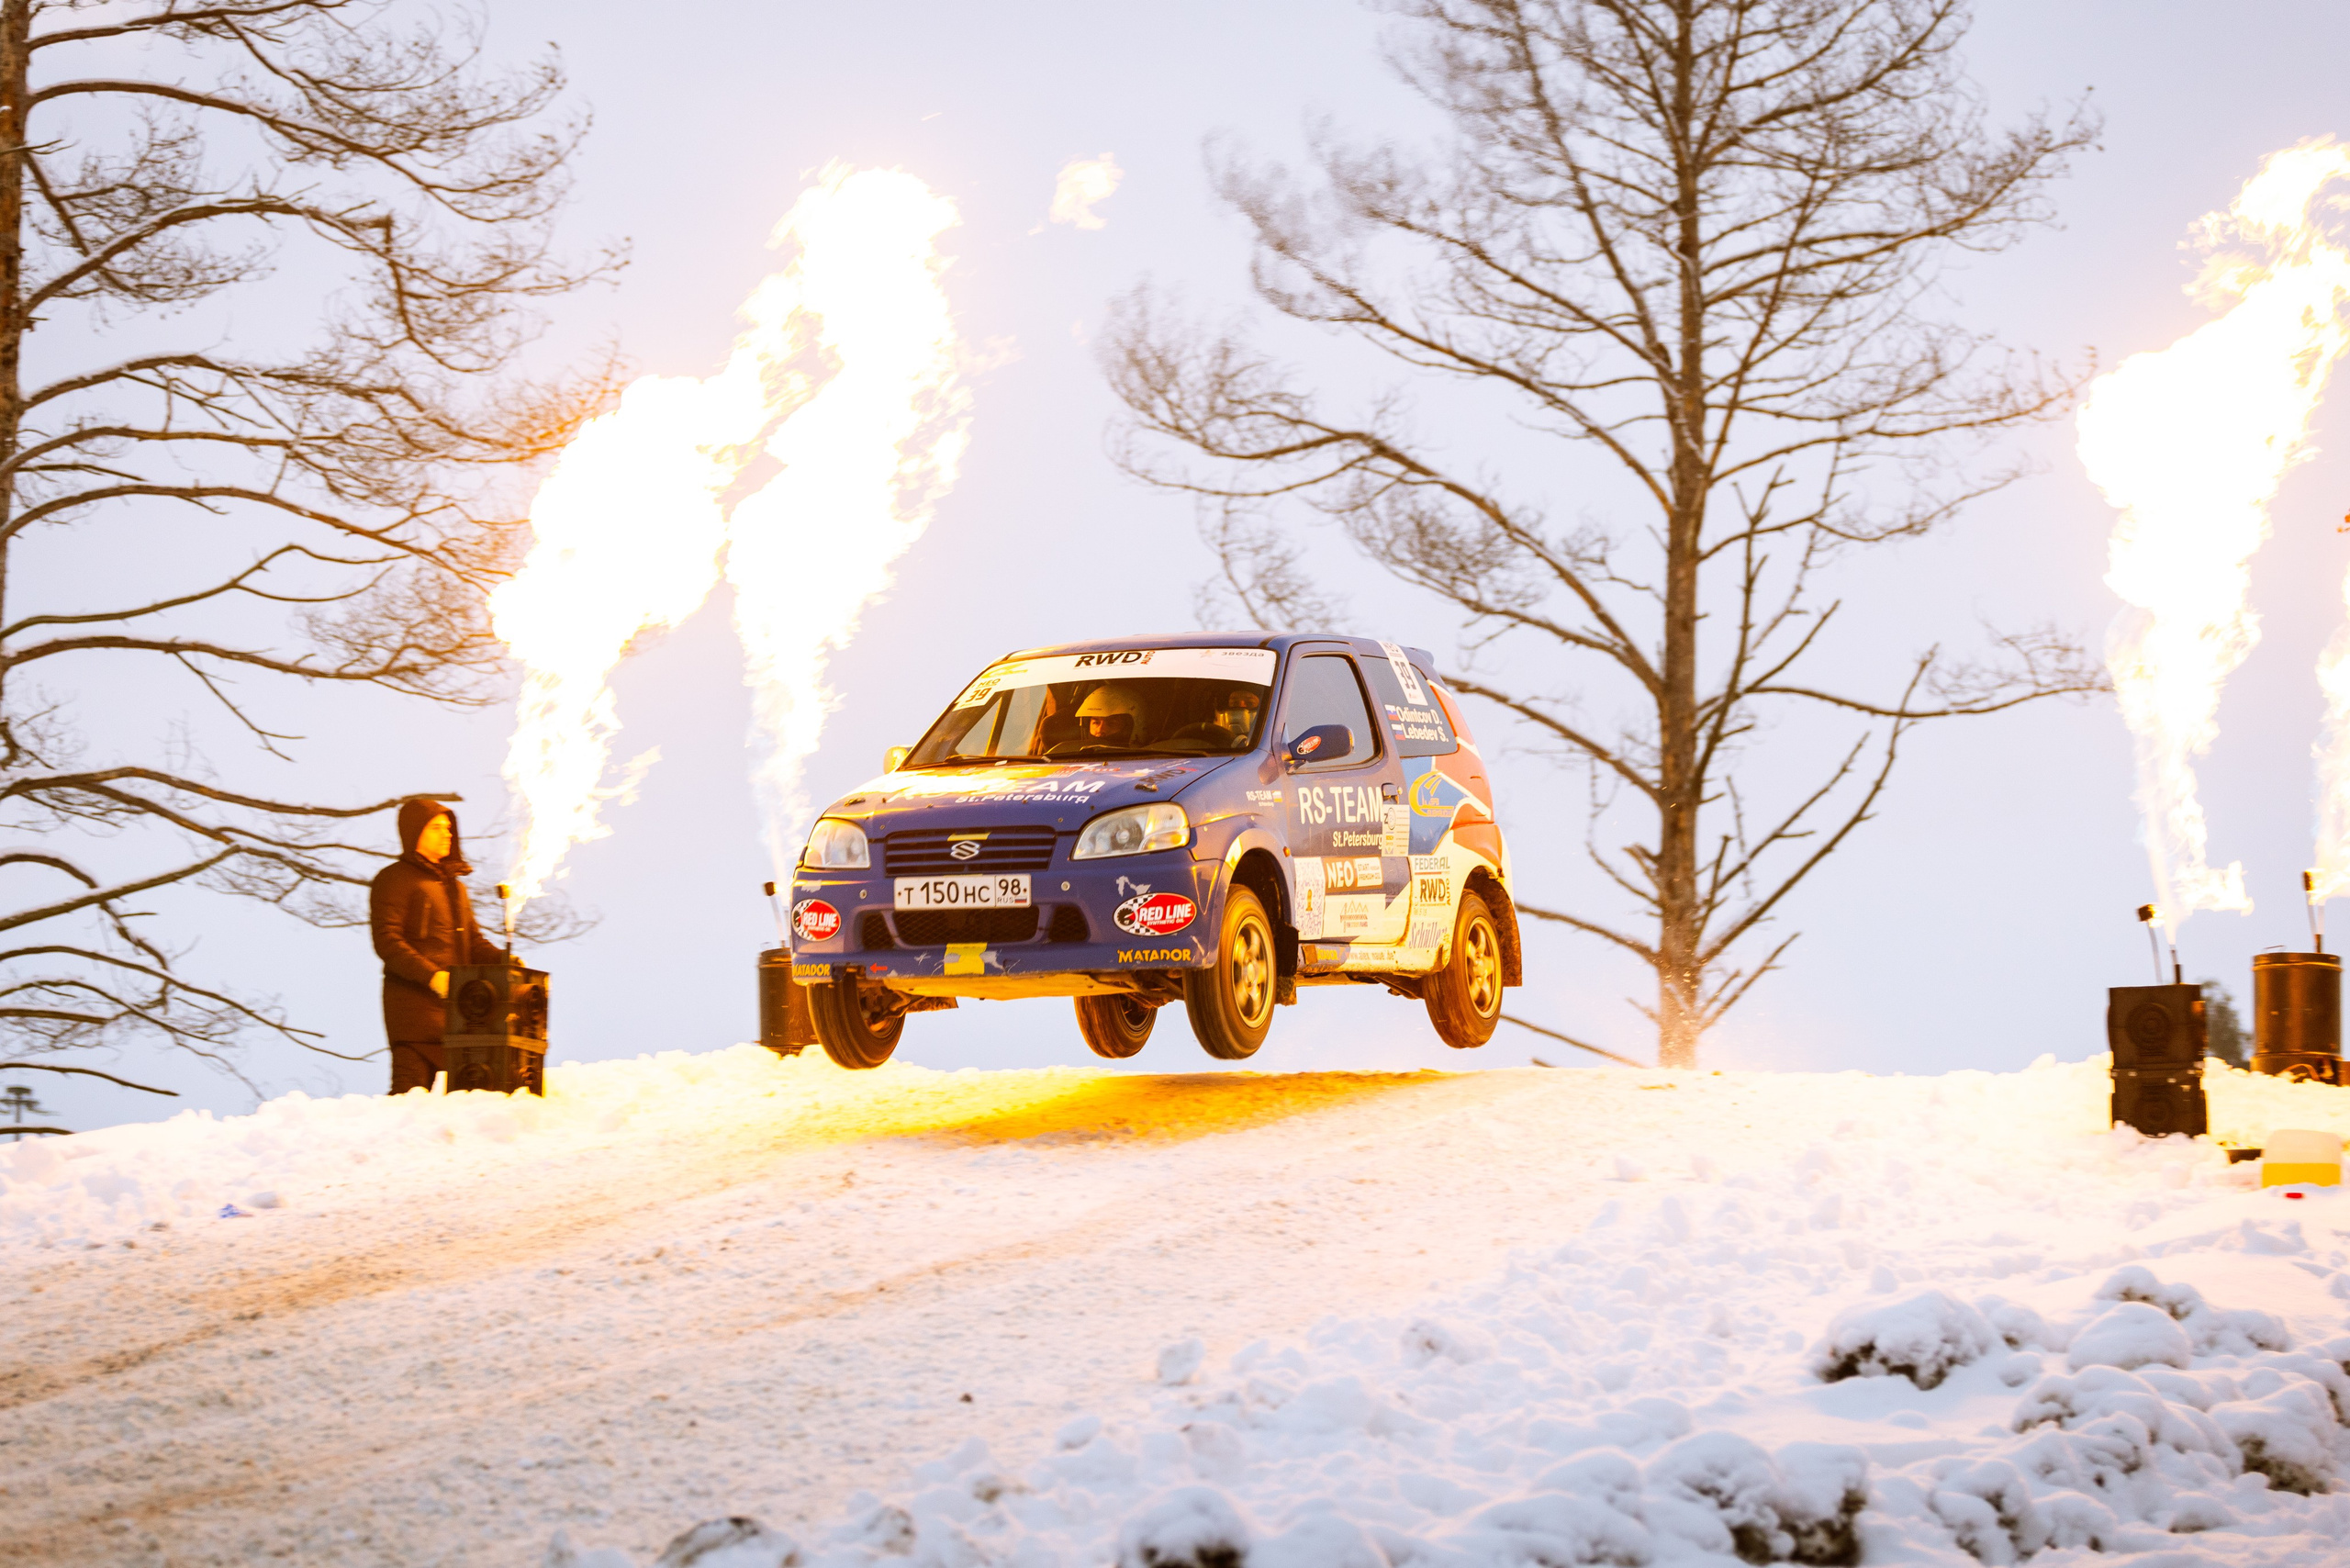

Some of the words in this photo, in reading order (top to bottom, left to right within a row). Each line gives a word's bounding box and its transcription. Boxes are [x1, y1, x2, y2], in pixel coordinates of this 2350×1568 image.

[1075, 652, 1142, 667] RWD
[1394, 661, 1416, 689] 39
[965, 688, 991, 702] 39
[1401, 723, 1438, 740] Lebedev
[1438, 726, 1449, 742] S.
[1298, 786, 1383, 824] RS-TEAM
[1333, 831, 1382, 847] St.Petersburg
[1415, 857, 1450, 870] FEDERAL
[1326, 860, 1354, 889] NEO
[920, 881, 959, 904] 150
[999, 879, 1021, 896] 98
[1420, 878, 1446, 902] RWD
[803, 912, 818, 926] RED
[819, 913, 838, 927] LINE
[1139, 906, 1163, 922] RED
[1166, 903, 1192, 919] LINE
[1117, 948, 1192, 963] MATADOR
